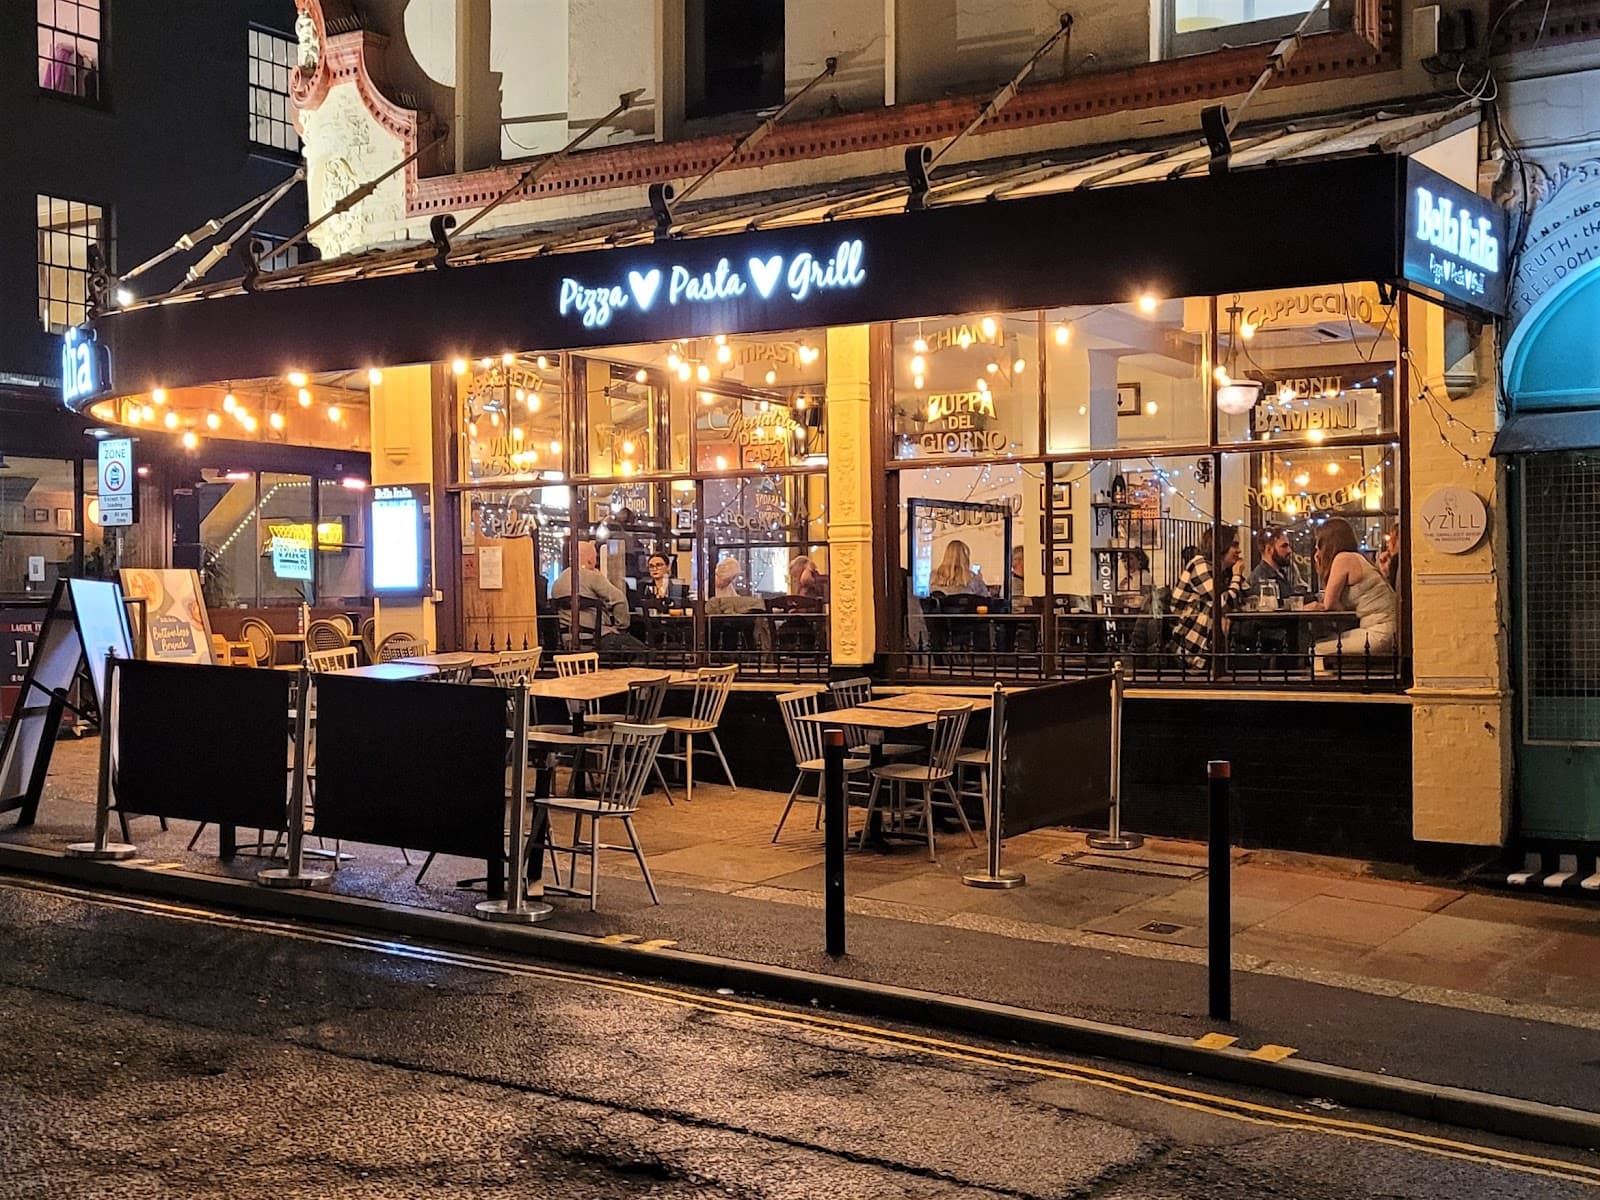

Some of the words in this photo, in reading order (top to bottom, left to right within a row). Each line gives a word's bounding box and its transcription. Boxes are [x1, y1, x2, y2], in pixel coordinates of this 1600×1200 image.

[1416, 187, 1459, 256] Bella
[1459, 208, 1499, 273] Italia
[1513, 237, 1571, 283] TRUTH
[559, 277, 629, 327] Pizza
[669, 257, 747, 305] Pasta
[787, 239, 866, 300] Grill
[1511, 247, 1593, 311] FREEDOM
[1245, 292, 1373, 328] CAPPUCCINO
[1275, 375, 1343, 399] MENU
[927, 390, 998, 423] ZUPPA
[1254, 399, 1358, 432] BAMBINI
[948, 415, 975, 430] DEL
[489, 436, 525, 457] VINO
[740, 430, 786, 446] DELLA
[920, 430, 1007, 455] GIORNO
[104, 448, 126, 459] ZONE
[744, 445, 786, 467] CASA
